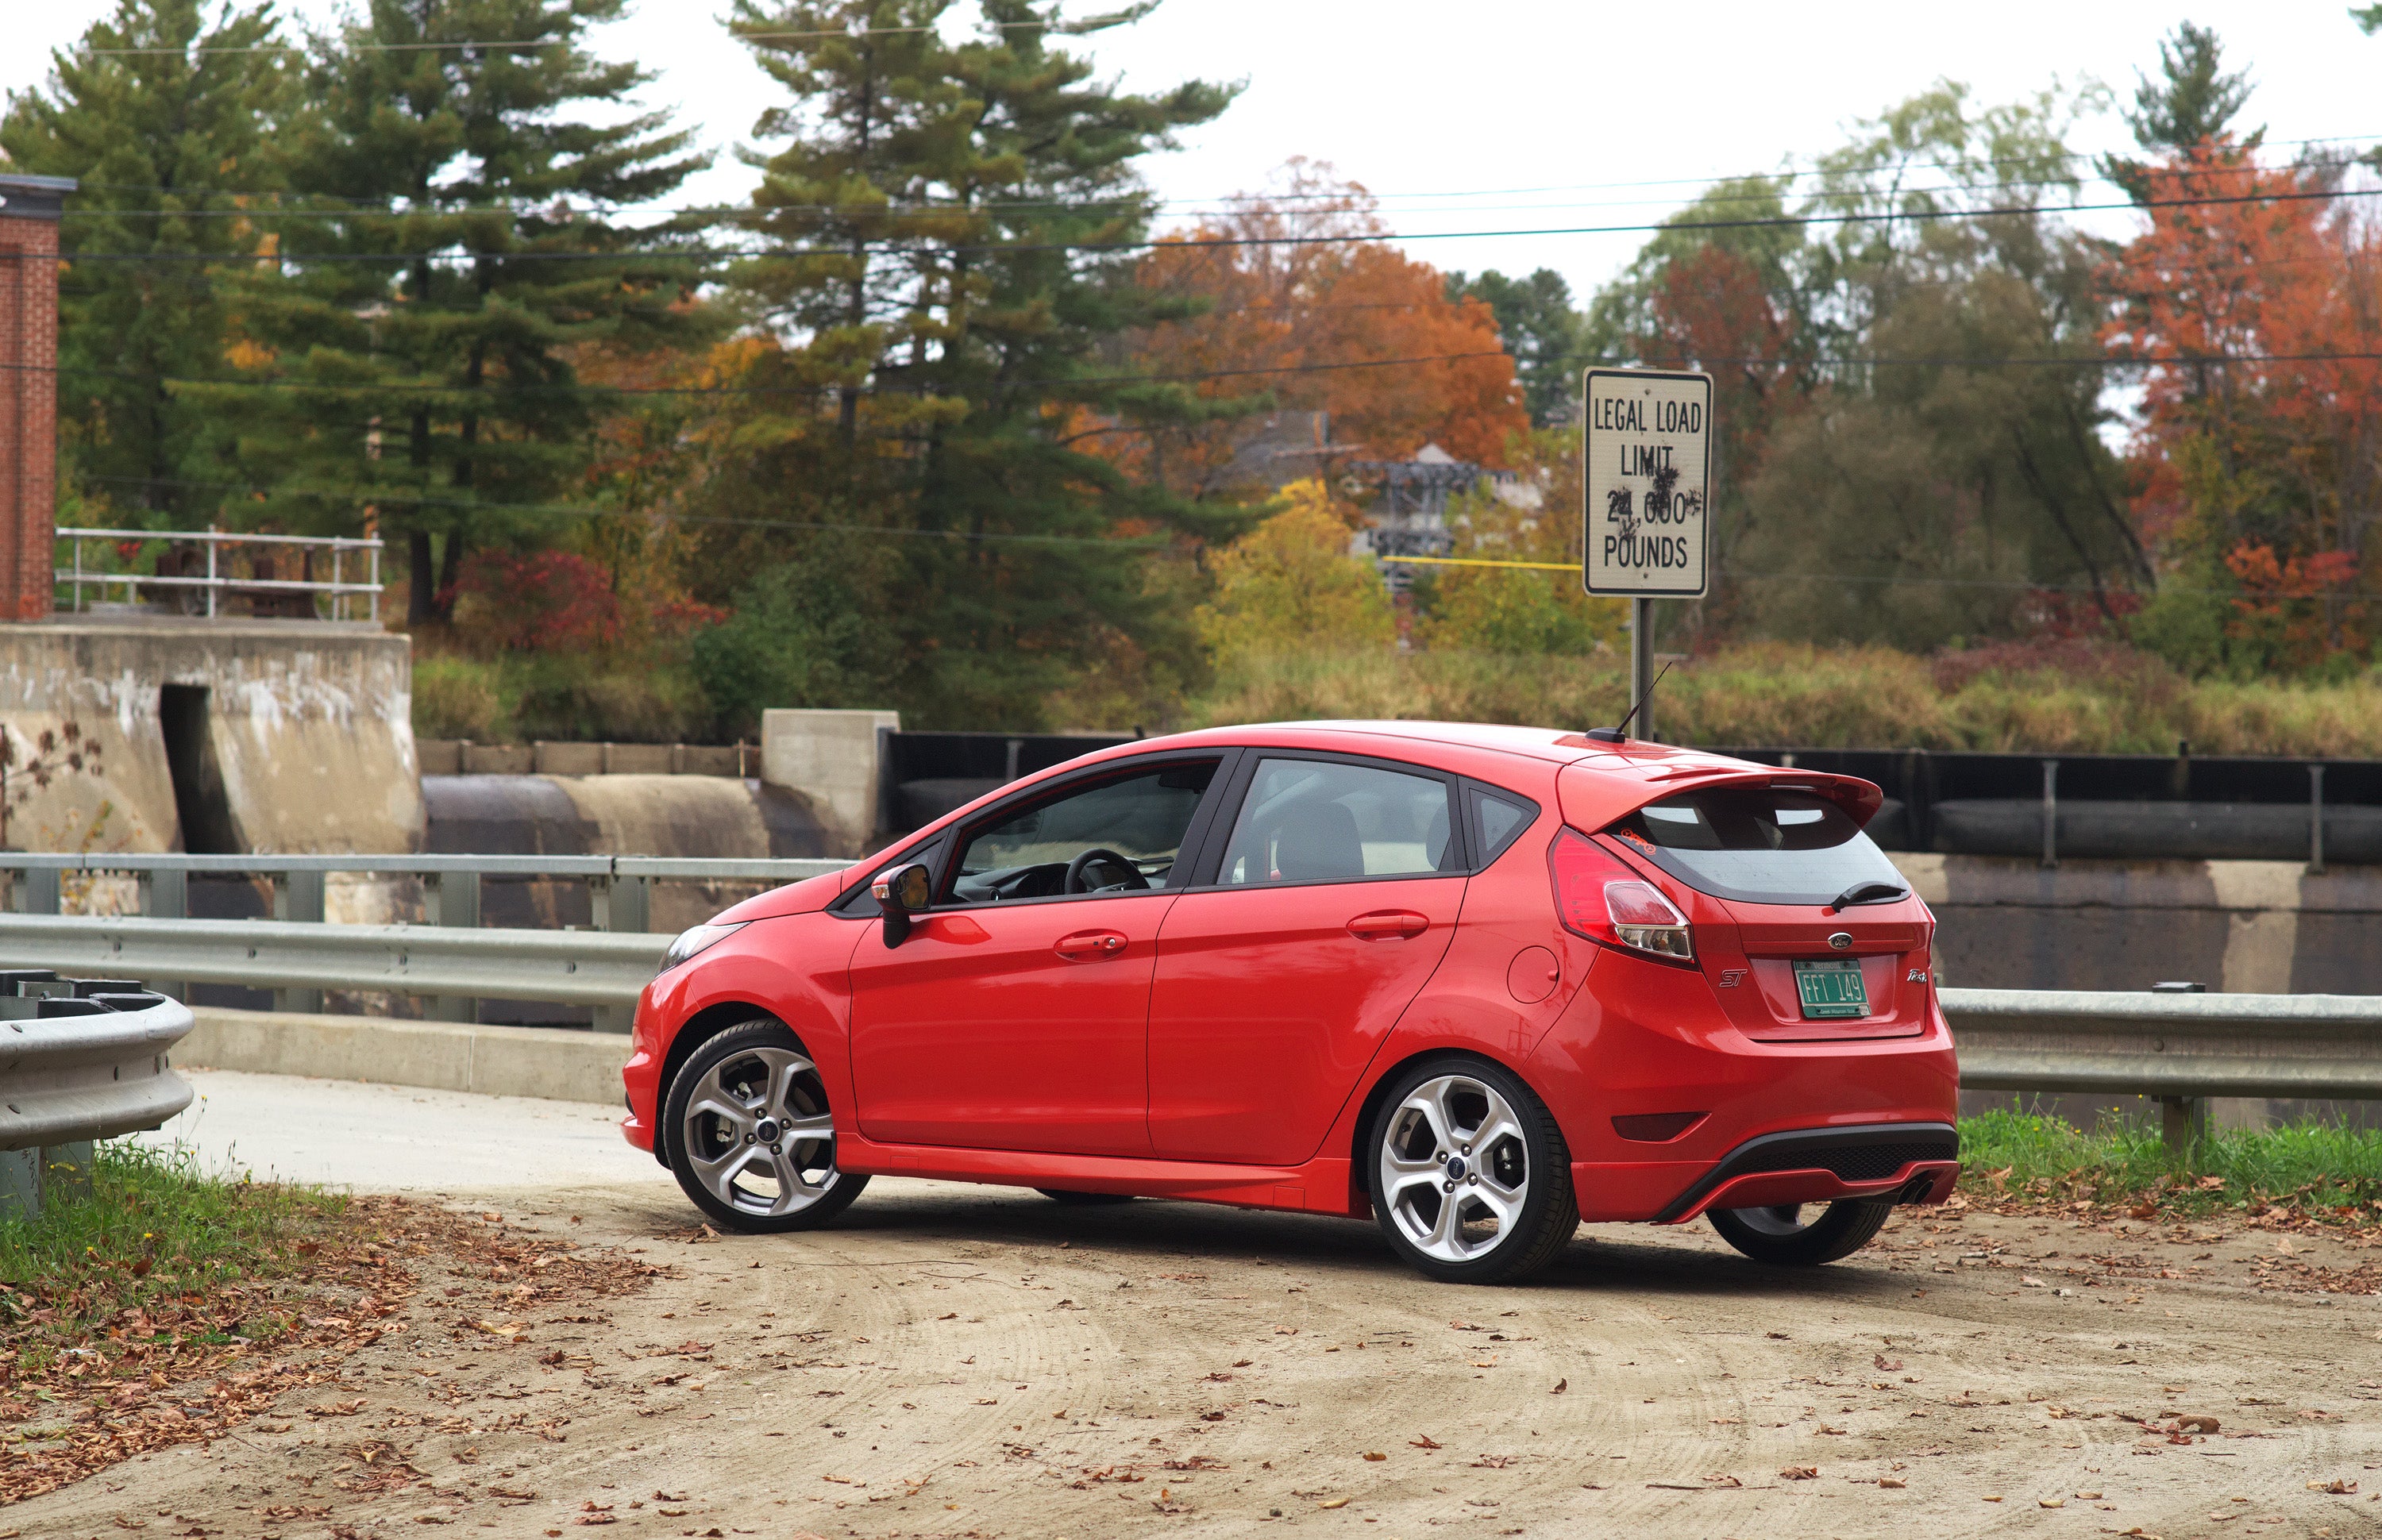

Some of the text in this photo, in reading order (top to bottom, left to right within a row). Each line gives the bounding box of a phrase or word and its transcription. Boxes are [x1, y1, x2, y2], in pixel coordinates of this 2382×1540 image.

[1595, 398, 1701, 433] LEGAL LOAD
[1621, 445, 1673, 476] LIMIT
[1605, 535, 1687, 568] POUNDS
[1720, 970, 1748, 987] ST
[1803, 974, 1863, 1002] FFT 149
